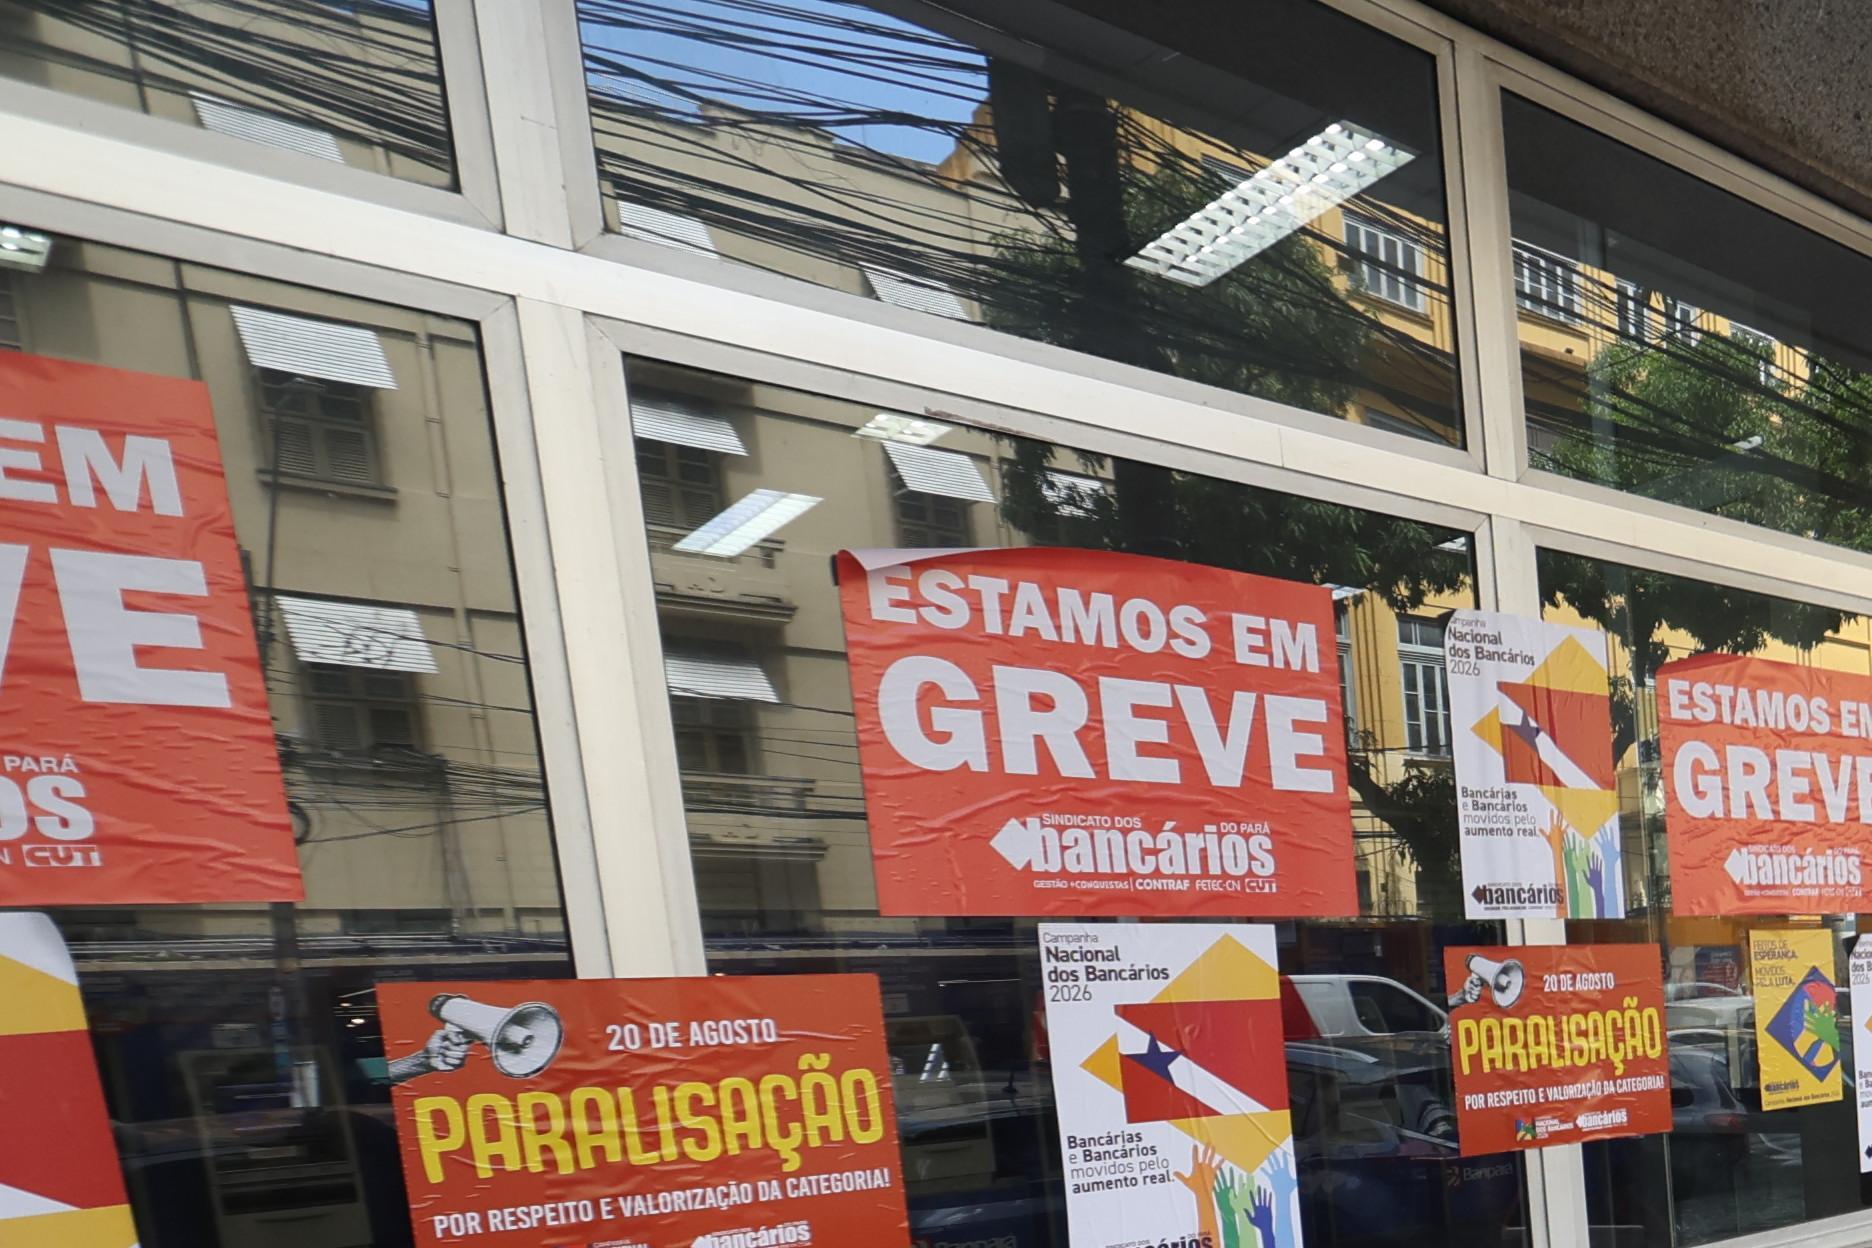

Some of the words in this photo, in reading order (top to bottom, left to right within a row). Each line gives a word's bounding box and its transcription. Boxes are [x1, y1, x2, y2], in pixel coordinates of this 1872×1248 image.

[867, 566, 1211, 660] ESTAMOS
[1231, 613, 1319, 673] EM
[1448, 626, 1502, 645] Nacional
[1449, 643, 1471, 659] dos
[1474, 646, 1535, 666] Bancários
[1450, 659, 1481, 676] 2026
[1668, 679, 1831, 735] ESTAMOS
[877, 655, 1334, 793] GREVE
[3, 753, 79, 773] PARÁ
[1461, 786, 1517, 801] Bancárias
[1472, 800, 1528, 813] Bancários
[1041, 814, 1111, 827] SINDICATO
[1114, 816, 1142, 828] DOS
[1220, 822, 1237, 833] DO
[1240, 820, 1270, 834] PARÁ
[1464, 813, 1511, 824] movidos
[1514, 812, 1537, 826] pelo
[1465, 826, 1513, 836] aumento
[1026, 817, 1276, 876] bancários
[1741, 847, 1861, 885] bancários
[1135, 879, 1190, 891] CONTRAF
[1483, 883, 1564, 906] bancários
[1043, 932, 1099, 944] Campanha
[1045, 946, 1121, 963] Nacional
[1047, 965, 1079, 983] dos
[1086, 963, 1170, 982] Bancários
[1543, 974, 1558, 993] 20
[1560, 973, 1574, 992] DE
[1576, 971, 1615, 991] AGOSTO
[1049, 984, 1092, 1003] 2026
[606, 1023, 641, 1051] 20
[649, 1022, 682, 1049] DE
[689, 1018, 778, 1046] AGOSTO
[1457, 996, 1662, 1076] PARALISAÇÃO
[1465, 1093, 1486, 1111] POR
[1487, 1088, 1536, 1108] RESPEITO
[1538, 1088, 1545, 1102] E
[1546, 1079, 1601, 1101] VALORIZAÇÃO
[1603, 1081, 1615, 1095] DA
[1616, 1075, 1664, 1095] CATEGORIA!
[413, 1053, 884, 1184] PARALISAÇÃO
[1066, 1131, 1143, 1149] Bancárias
[1069, 1152, 1079, 1164] e
[1082, 1143, 1157, 1162] Bancários
[1070, 1162, 1135, 1180] movidos
[1139, 1157, 1170, 1176] pelo
[1071, 1174, 1138, 1194] aumento
[1142, 1169, 1175, 1187] real.
[433, 1212, 484, 1239] POR
[487, 1199, 594, 1233] RESPEITO
[600, 1196, 616, 1220] E
[617, 1180, 752, 1218] VALORIZAÇÃO
[758, 1180, 783, 1202] DA
[786, 1167, 891, 1198] CATEGORIA!
